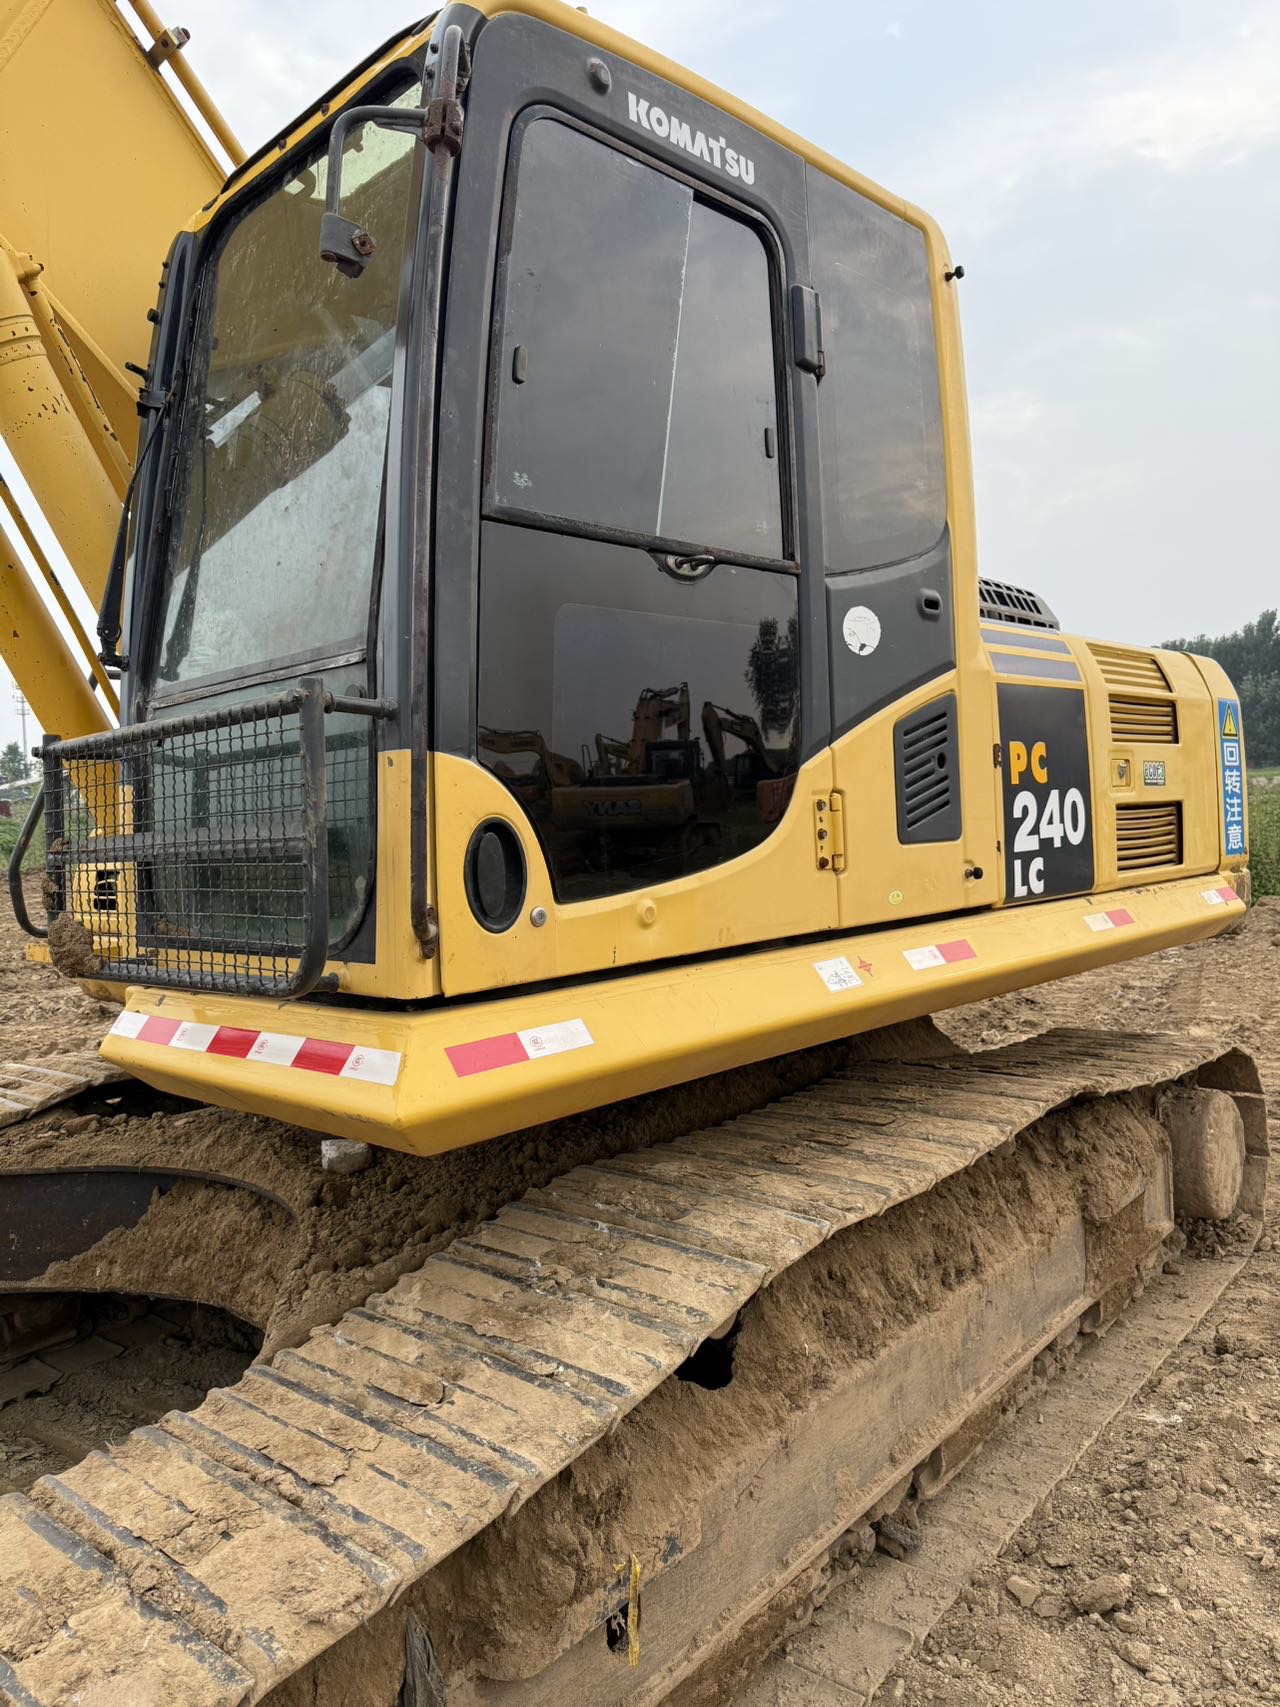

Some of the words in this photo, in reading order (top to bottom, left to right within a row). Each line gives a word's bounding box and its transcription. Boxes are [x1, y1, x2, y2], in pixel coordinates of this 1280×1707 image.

[628, 91, 755, 185] KOMATSU
[1008, 741, 1048, 785] PC
[1012, 787, 1086, 853] 240
[1223, 742, 1244, 851] 回转注意
[1013, 856, 1045, 898] LC
